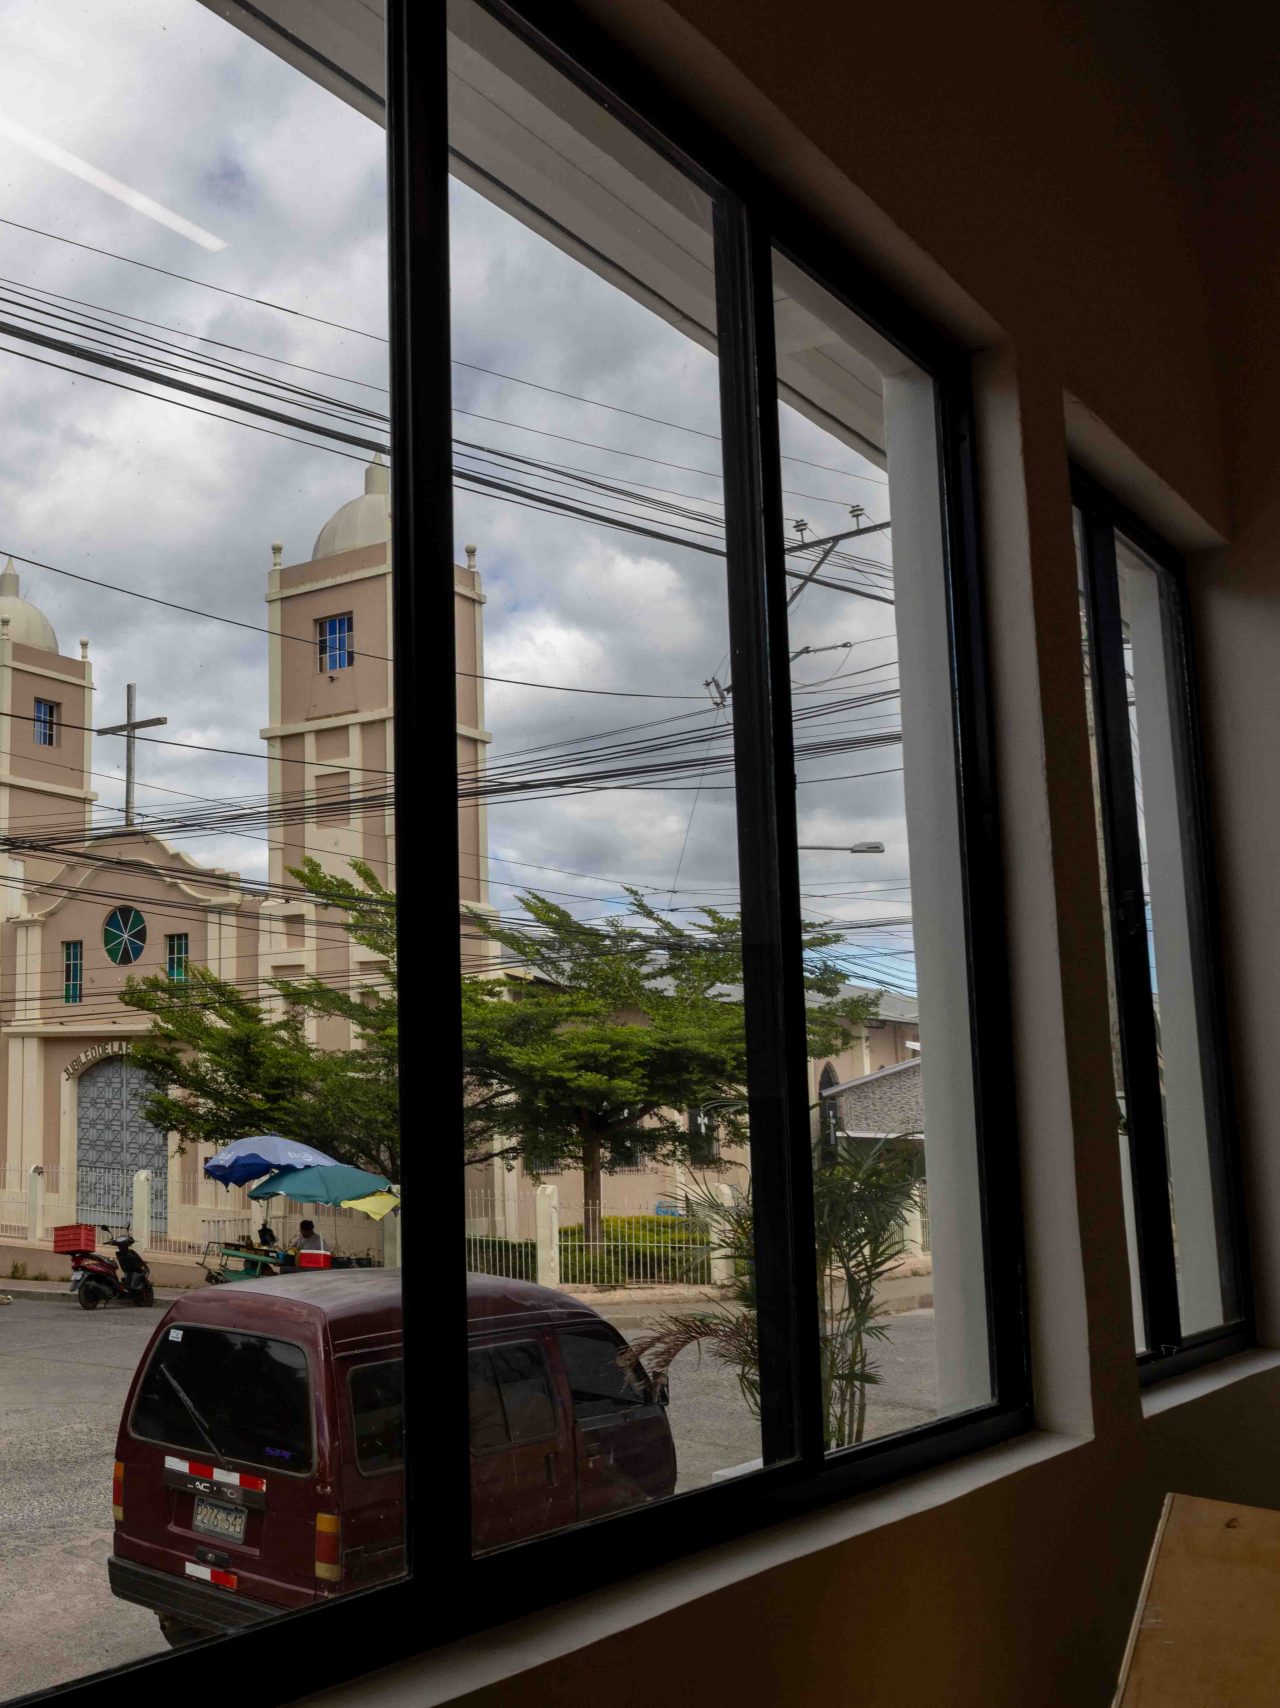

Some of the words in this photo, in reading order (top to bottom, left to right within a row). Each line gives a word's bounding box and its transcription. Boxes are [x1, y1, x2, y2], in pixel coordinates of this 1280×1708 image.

[64, 1046, 98, 1081] JUBILEO
[97, 1043, 111, 1056] DE
[111, 1041, 123, 1054] LA
